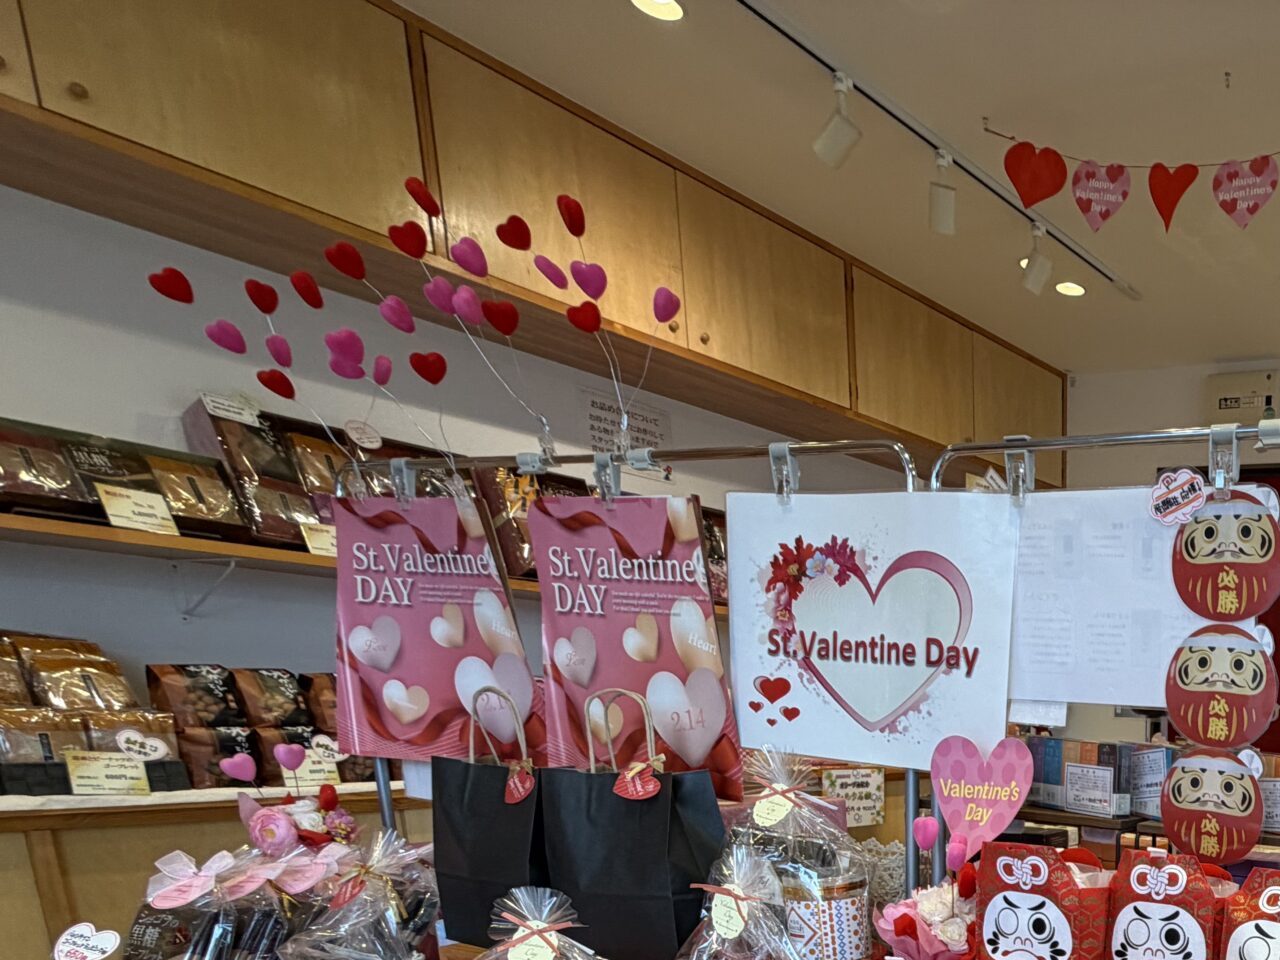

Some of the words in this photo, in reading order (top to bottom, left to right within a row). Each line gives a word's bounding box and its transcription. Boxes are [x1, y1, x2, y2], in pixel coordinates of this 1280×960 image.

[1088, 177, 1115, 190] Happy
[1231, 175, 1263, 188] Happy
[1090, 201, 1107, 212] Day
[1236, 199, 1255, 210] Day
[352, 542, 490, 575] St.Valentine
[548, 546, 697, 583] St.Valentine
[354, 575, 415, 606] DAY
[552, 582, 609, 615] DAY
[1217, 565, 1240, 615] 必勝
[688, 631, 718, 656] Heart
[767, 629, 917, 666] St.Valentine
[925, 637, 980, 678] Day
[670, 707, 707, 733] 2.14
[1206, 694, 1230, 741] 必勝
[939, 778, 1020, 802] Valentine's
[965, 803, 993, 827] Day
[1199, 813, 1221, 858] 必勝
[138, 911, 179, 928] ショコラの
[127, 924, 163, 948] 黒糖
